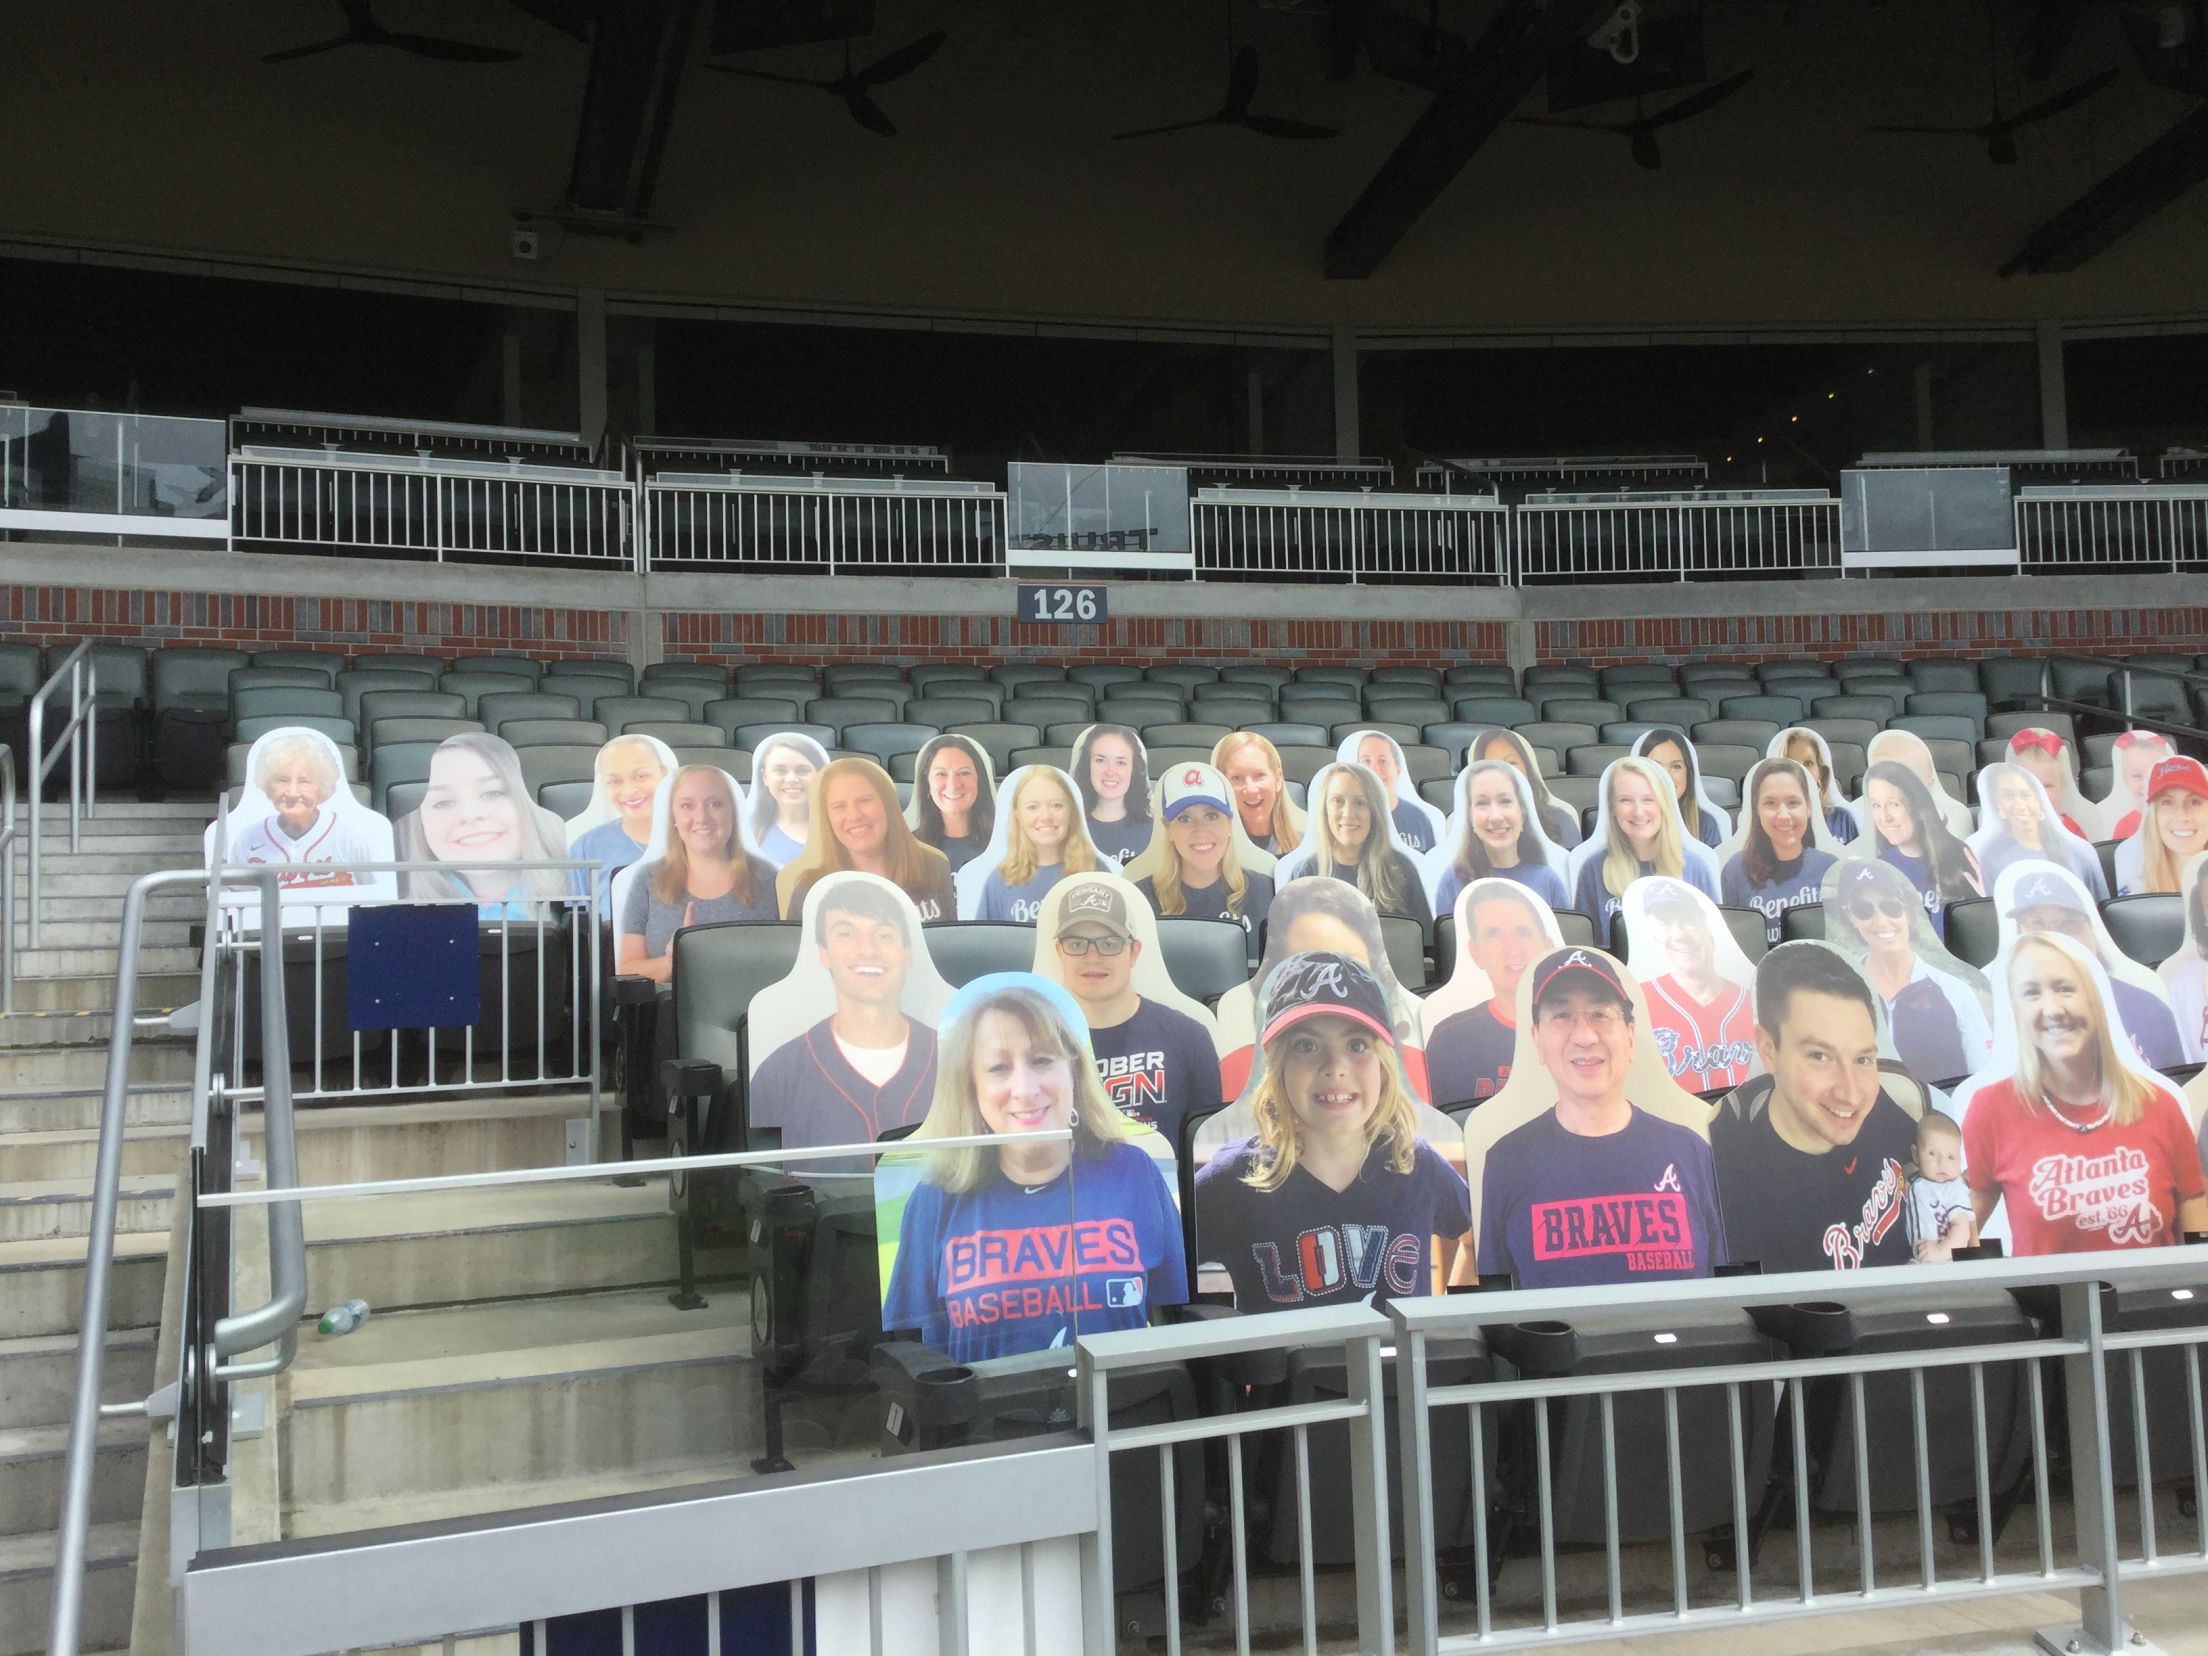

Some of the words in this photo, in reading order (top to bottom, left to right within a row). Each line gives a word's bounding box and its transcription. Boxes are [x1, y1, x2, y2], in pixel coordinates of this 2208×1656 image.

[1034, 589, 1097, 620] 126
[1749, 886, 1823, 919] Benefit
[2025, 878, 2052, 898] A
[1558, 950, 1592, 969] A
[1300, 963, 1348, 998] A
[1654, 1163, 1681, 1192] A
[2031, 1148, 2147, 1193] Atlanta
[2037, 1178, 2147, 1217] Braves
[1543, 1199, 1681, 1253] BRAVES
[952, 1224, 1135, 1285] BRAVES
[1626, 1251, 1695, 1272] BASEBALL
[949, 1281, 1103, 1329] BASEBALL
